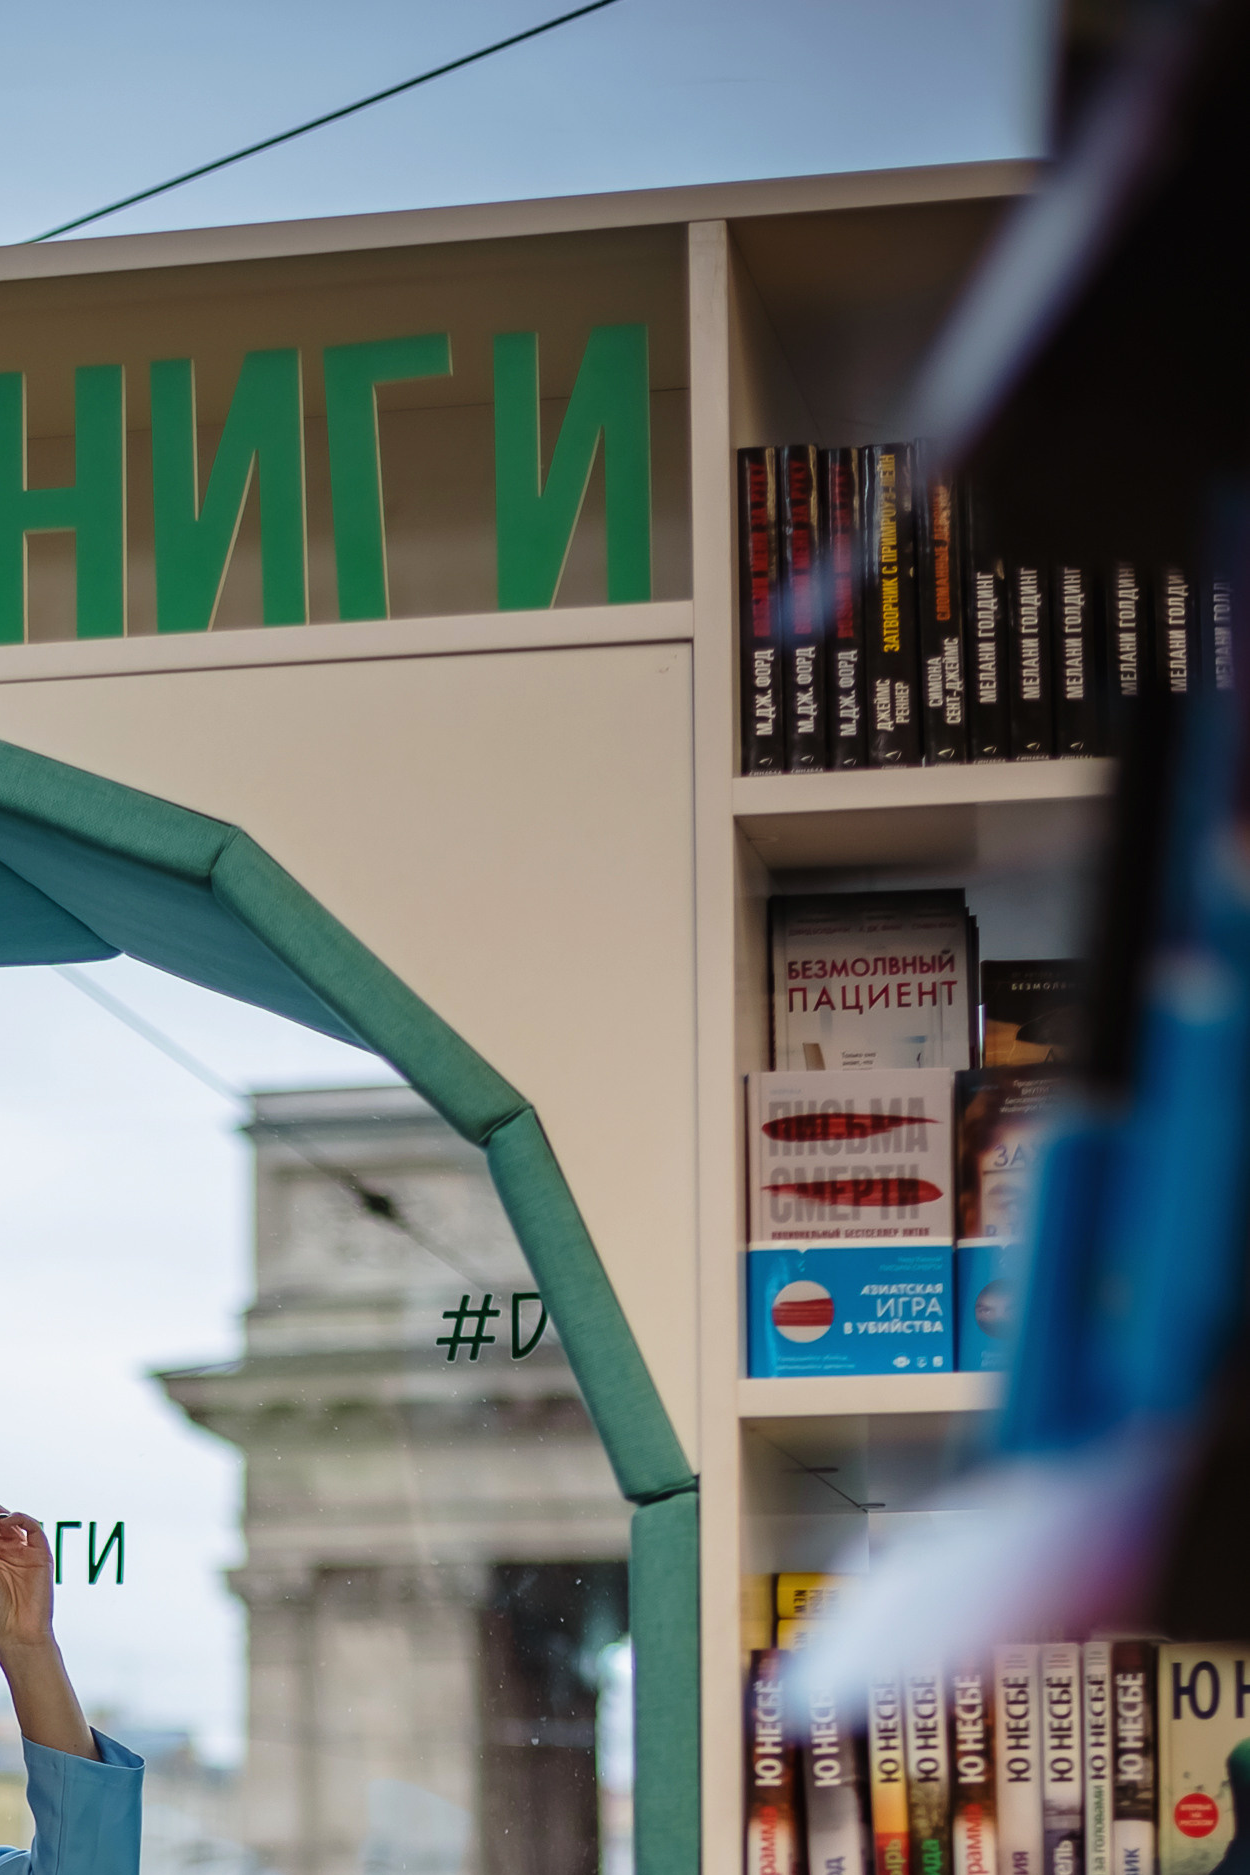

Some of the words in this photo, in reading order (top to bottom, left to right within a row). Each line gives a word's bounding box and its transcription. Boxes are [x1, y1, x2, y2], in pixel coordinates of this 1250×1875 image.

[884, 566, 898, 574] С
[935, 546, 951, 621] СЛОМАННЫЕ
[882, 578, 900, 652] ЗАТВОРНИК
[977, 571, 997, 637] ГОЛДИНГ
[1019, 567, 1042, 634] ГОЛДИНГ
[1063, 567, 1086, 633] ГОЛДИНГ
[1164, 567, 1188, 625] ГОЛДИ
[754, 649, 774, 687] ФОРД
[796, 646, 816, 685] ФОРД
[837, 650, 858, 687] ФОРД
[942, 637, 961, 724] СЕНТ-ДЖЕЙМС
[979, 641, 997, 703] МЕЛАНИ
[1021, 638, 1041, 699] МЕЛАНИ
[1065, 637, 1084, 699] МЕЛАНИ
[1119, 632, 1138, 695] МЕЛАНИ
[1168, 629, 1188, 692] МЕЛАНИ
[892, 681, 910, 723] РЕННЕР
[927, 657, 943, 707] СИМОНА
[876, 679, 893, 731] ДЖЕЙМС
[788, 949, 955, 980] БЕЗМОЛВНЫЙ
[788, 980, 958, 1015] ПАЦИЕНТ
[768, 1097, 928, 1158] ПИСЬМА
[770, 1164, 920, 1224] СМЕРТИ
[860, 1283, 943, 1296] АЗИАТСКАЯ
[876, 1297, 943, 1318] ИГРА
[843, 1323, 852, 1334] В
[857, 1319, 944, 1334] УБИЙСТВА
[1172, 1661, 1220, 1719] Ю
[810, 1678, 841, 1754] НЕСБ
[755, 1757, 783, 1787] Ю
[813, 1757, 842, 1787] Ю
[878, 1758, 899, 1783] Ю
[916, 1757, 939, 1782] Ю
[959, 1755, 985, 1783] Ю
[1007, 1758, 1032, 1782] Ю
[1050, 1758, 1074, 1782] Ю
[1089, 1755, 1107, 1780] Ю
[1119, 1753, 1144, 1780] Ю
[1091, 1785, 1106, 1853] головами
[1094, 1857, 1106, 1872] за
